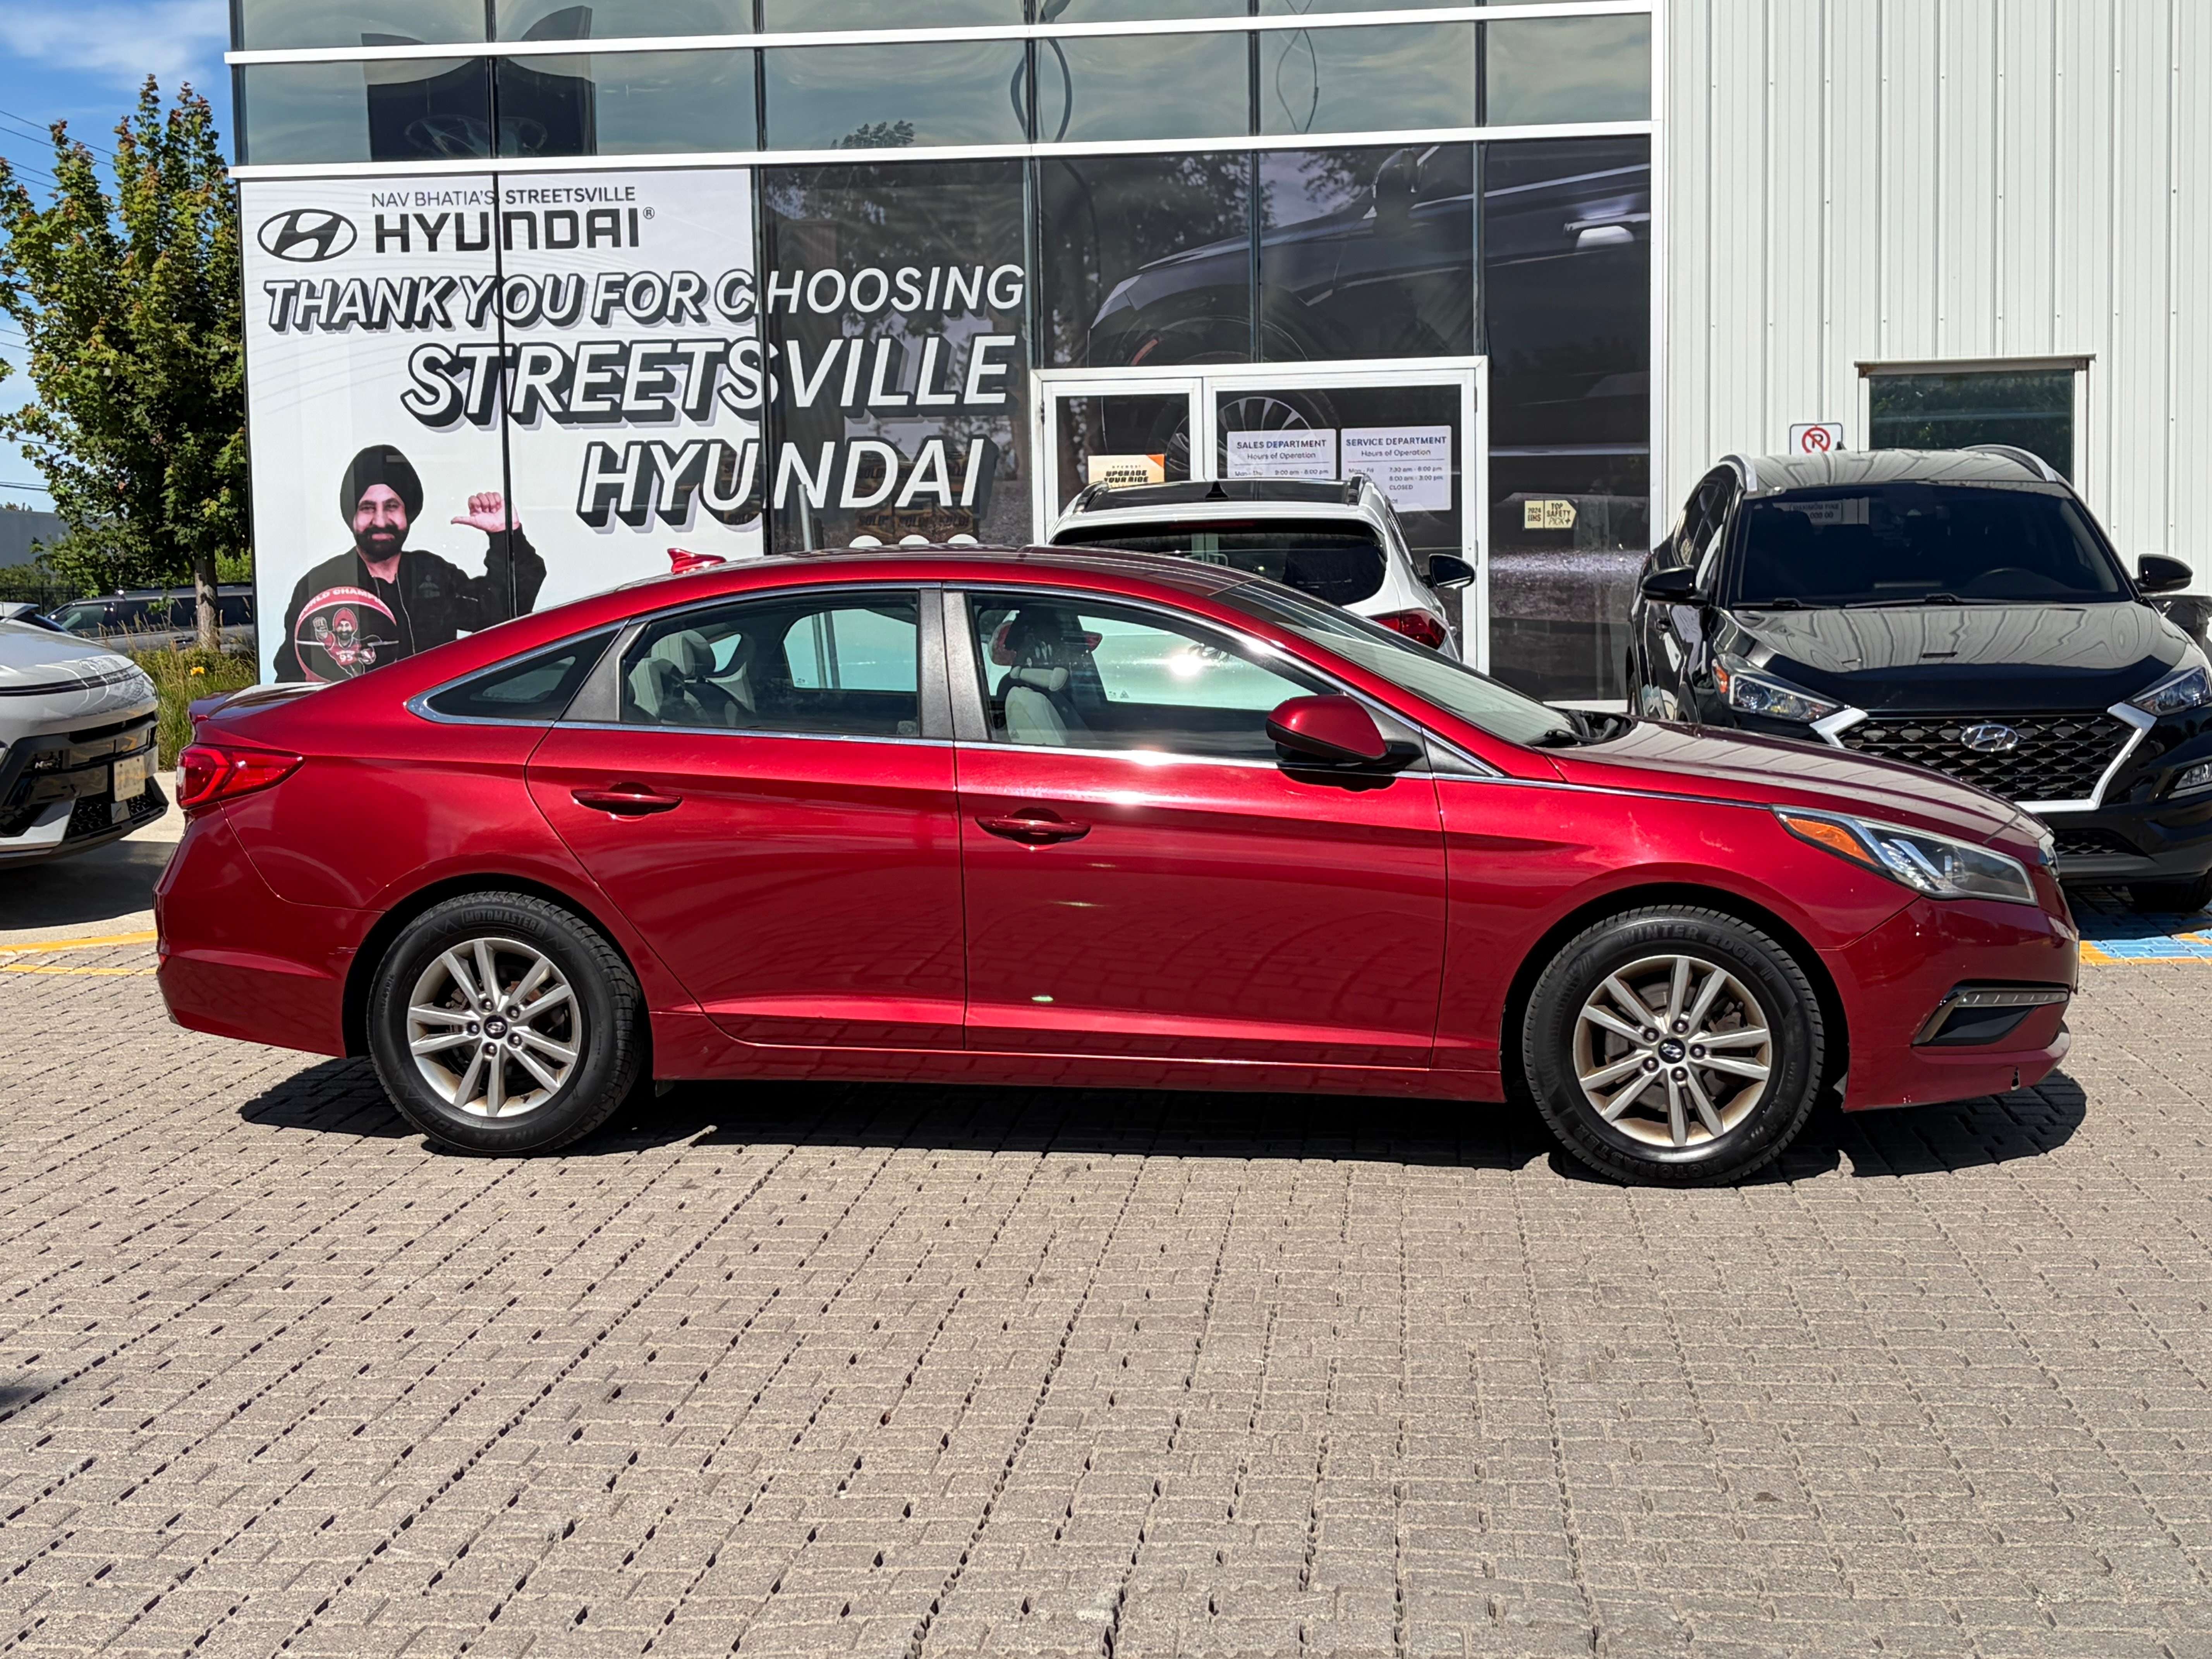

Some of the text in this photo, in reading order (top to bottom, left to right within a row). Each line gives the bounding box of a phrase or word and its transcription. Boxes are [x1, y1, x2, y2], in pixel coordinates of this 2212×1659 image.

[371, 186, 636, 207] NAV BHATIA'S STREETSVILLE
[264, 264, 1025, 334] THANK YOU FOR CHOOSING
[399, 331, 1019, 429] STREETSVILLE
[1237, 440, 1327, 449] SALES DEPARTMENT
[1386, 436, 1447, 445] DEPARTMENT
[576, 434, 1000, 530] HYUNDAI
[465, 909, 538, 931] MOTOMASTER
[1619, 924, 1700, 945] WINTER
[1706, 932, 1757, 967] EDGE
[1573, 1123, 1725, 1180] MOTOMASTER
